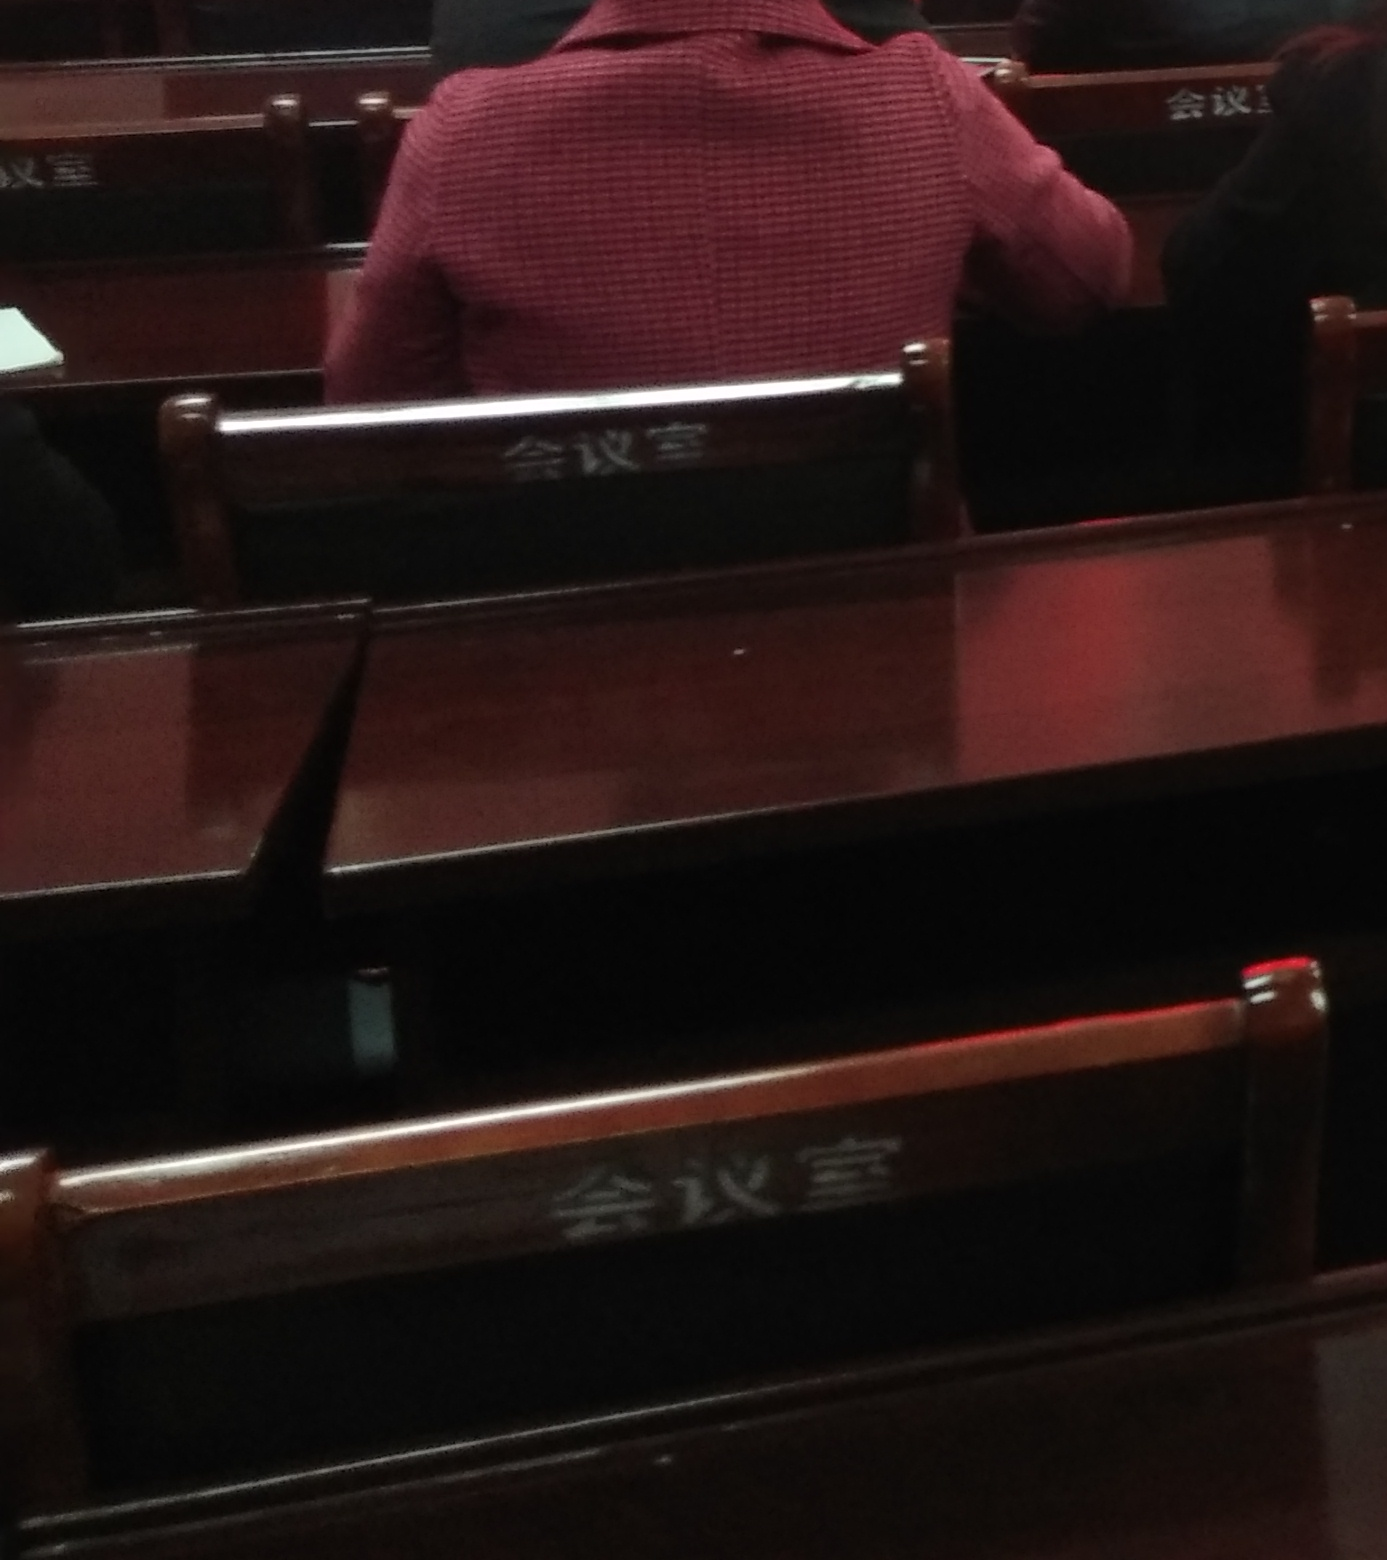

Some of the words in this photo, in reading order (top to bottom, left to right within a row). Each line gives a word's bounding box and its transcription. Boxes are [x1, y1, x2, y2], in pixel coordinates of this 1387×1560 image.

[504, 420, 709, 481] 会议室
[548, 1136, 902, 1241] 会议室
